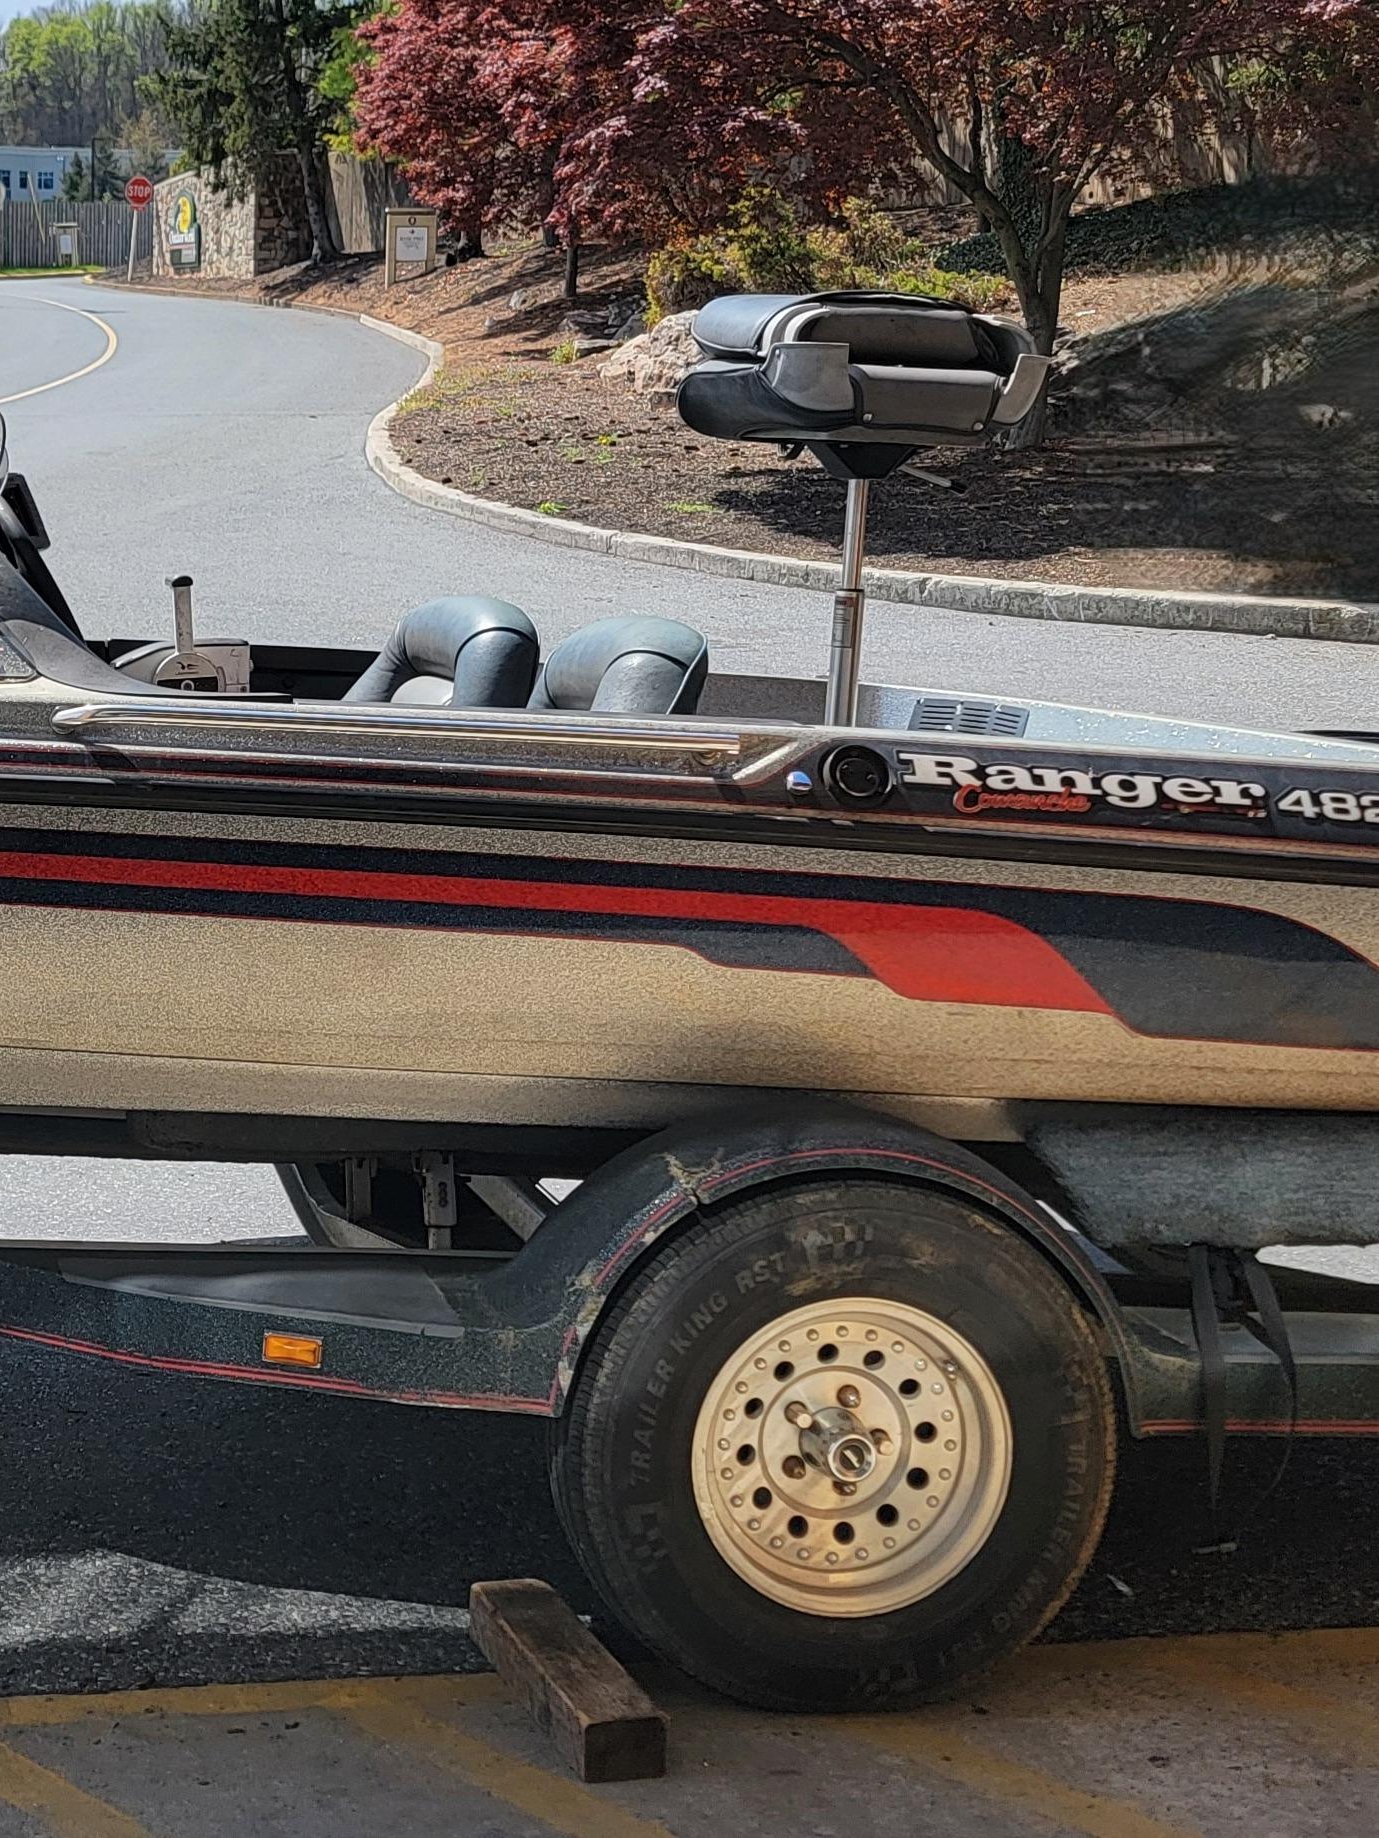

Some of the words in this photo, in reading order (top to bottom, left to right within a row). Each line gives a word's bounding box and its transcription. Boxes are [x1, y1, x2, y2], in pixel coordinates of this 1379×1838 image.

[127, 185, 151, 198] STOP
[898, 752, 1267, 808] Ranger
[1277, 789, 1379, 824] 482
[630, 1357, 674, 1486] TRAILER
[669, 1293, 729, 1356] KING
